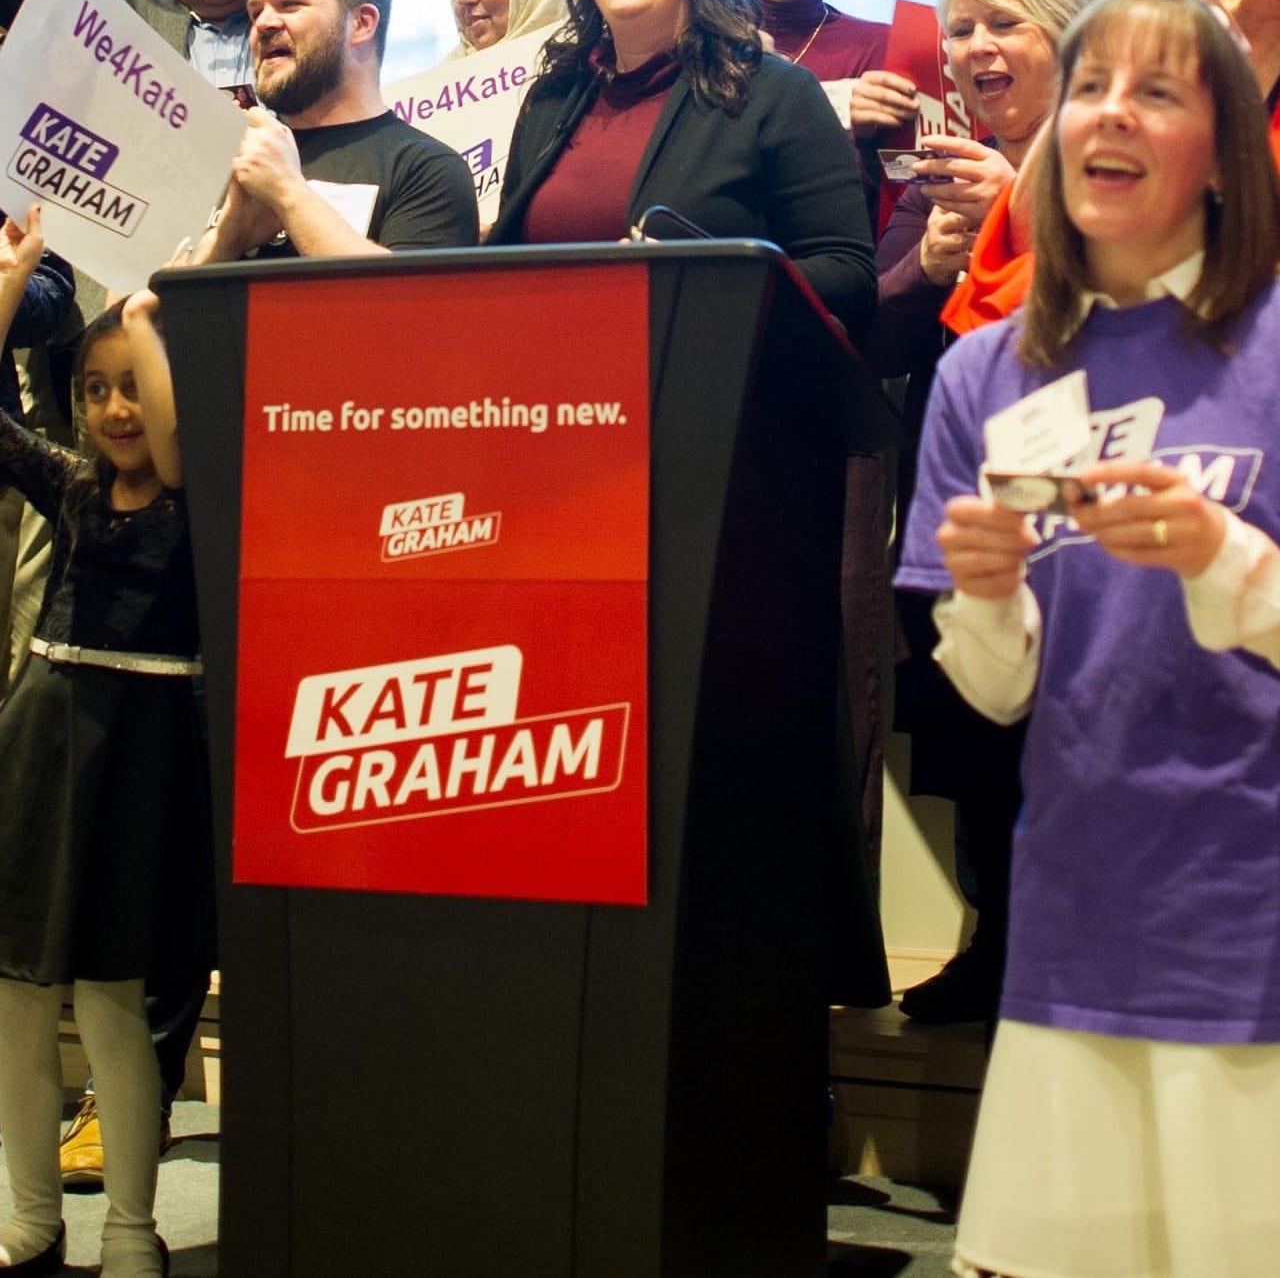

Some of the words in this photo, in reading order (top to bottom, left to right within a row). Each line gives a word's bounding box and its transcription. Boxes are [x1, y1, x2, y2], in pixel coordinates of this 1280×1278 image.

[73, 0, 188, 129] We4Kate
[30, 112, 110, 172] KATE
[16, 148, 136, 227] GRAHAM
[263, 403, 333, 432] Time
[341, 401, 383, 430] for
[391, 398, 548, 433] something
[557, 401, 627, 427] new.
[387, 518, 493, 556] GRAHAM
[390, 498, 458, 528] KATE
[315, 662, 495, 742] KATE
[308, 718, 605, 815] GRAHAM
